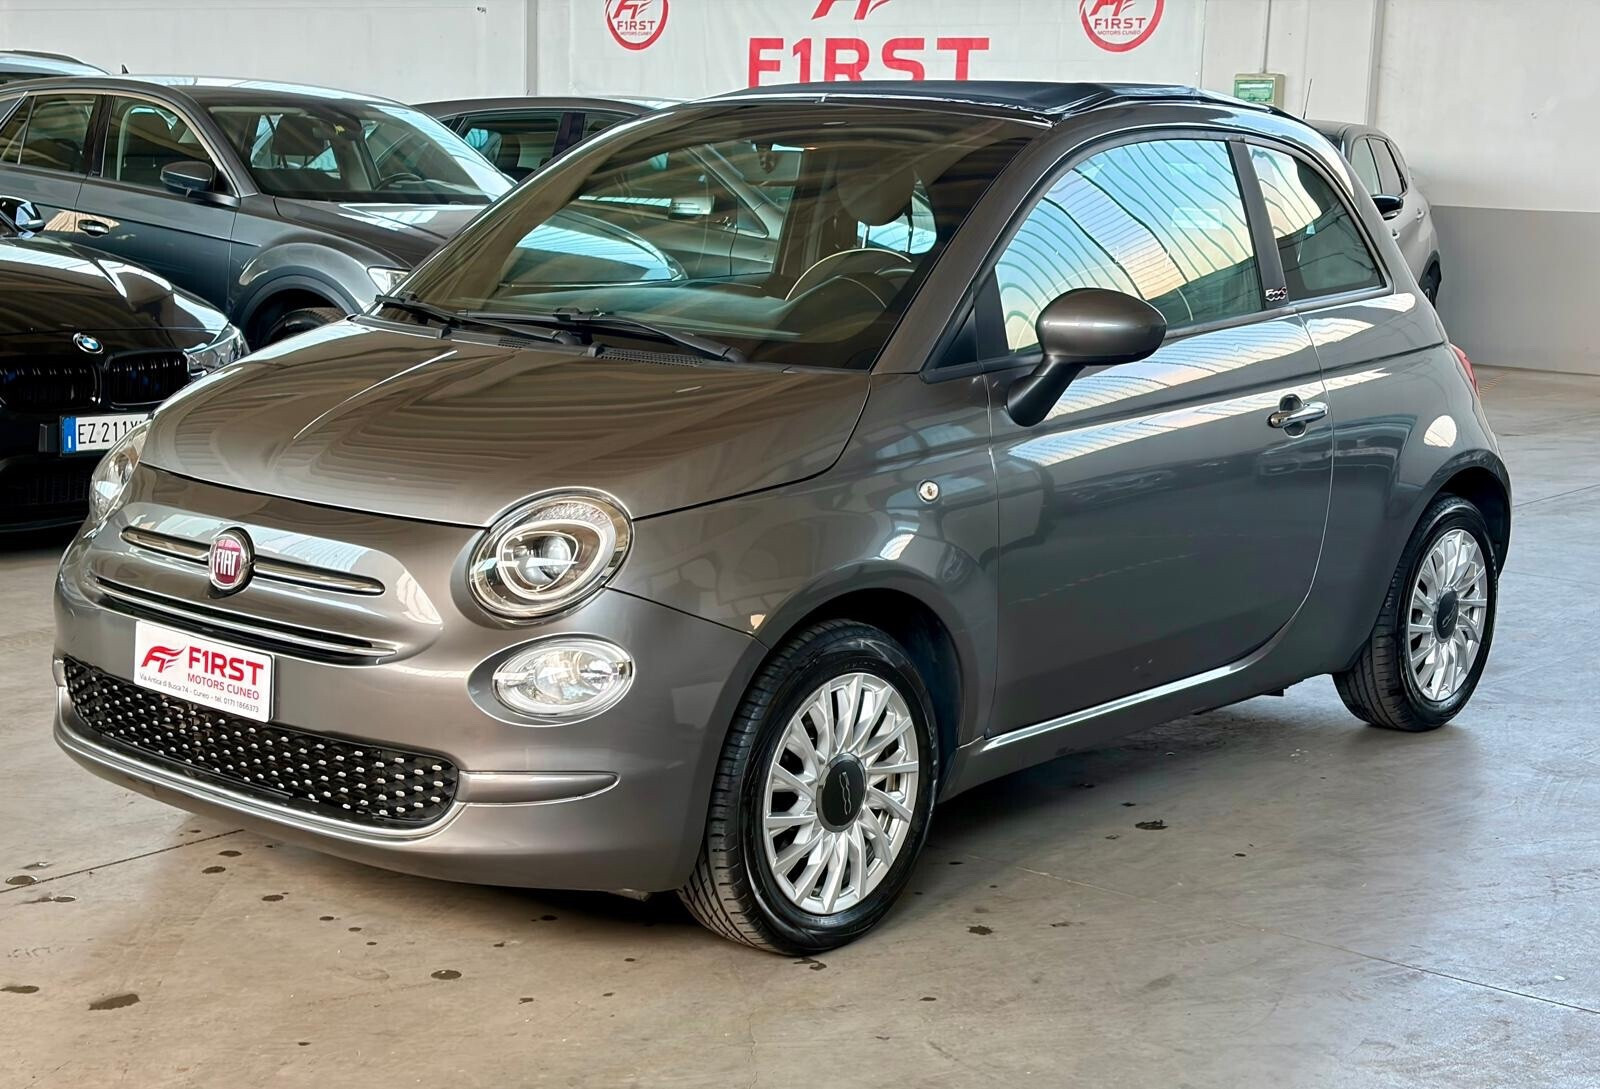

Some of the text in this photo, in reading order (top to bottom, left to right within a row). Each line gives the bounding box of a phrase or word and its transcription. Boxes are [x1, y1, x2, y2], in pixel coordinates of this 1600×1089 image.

[617, 21, 655, 30] F1RST
[1094, 18, 1146, 29] F1RST
[748, 37, 990, 89] F1RST
[216, 549, 239, 576] FIAT
[188, 646, 264, 685] F1RST
[187, 673, 260, 701] MOTORS CUNEO
